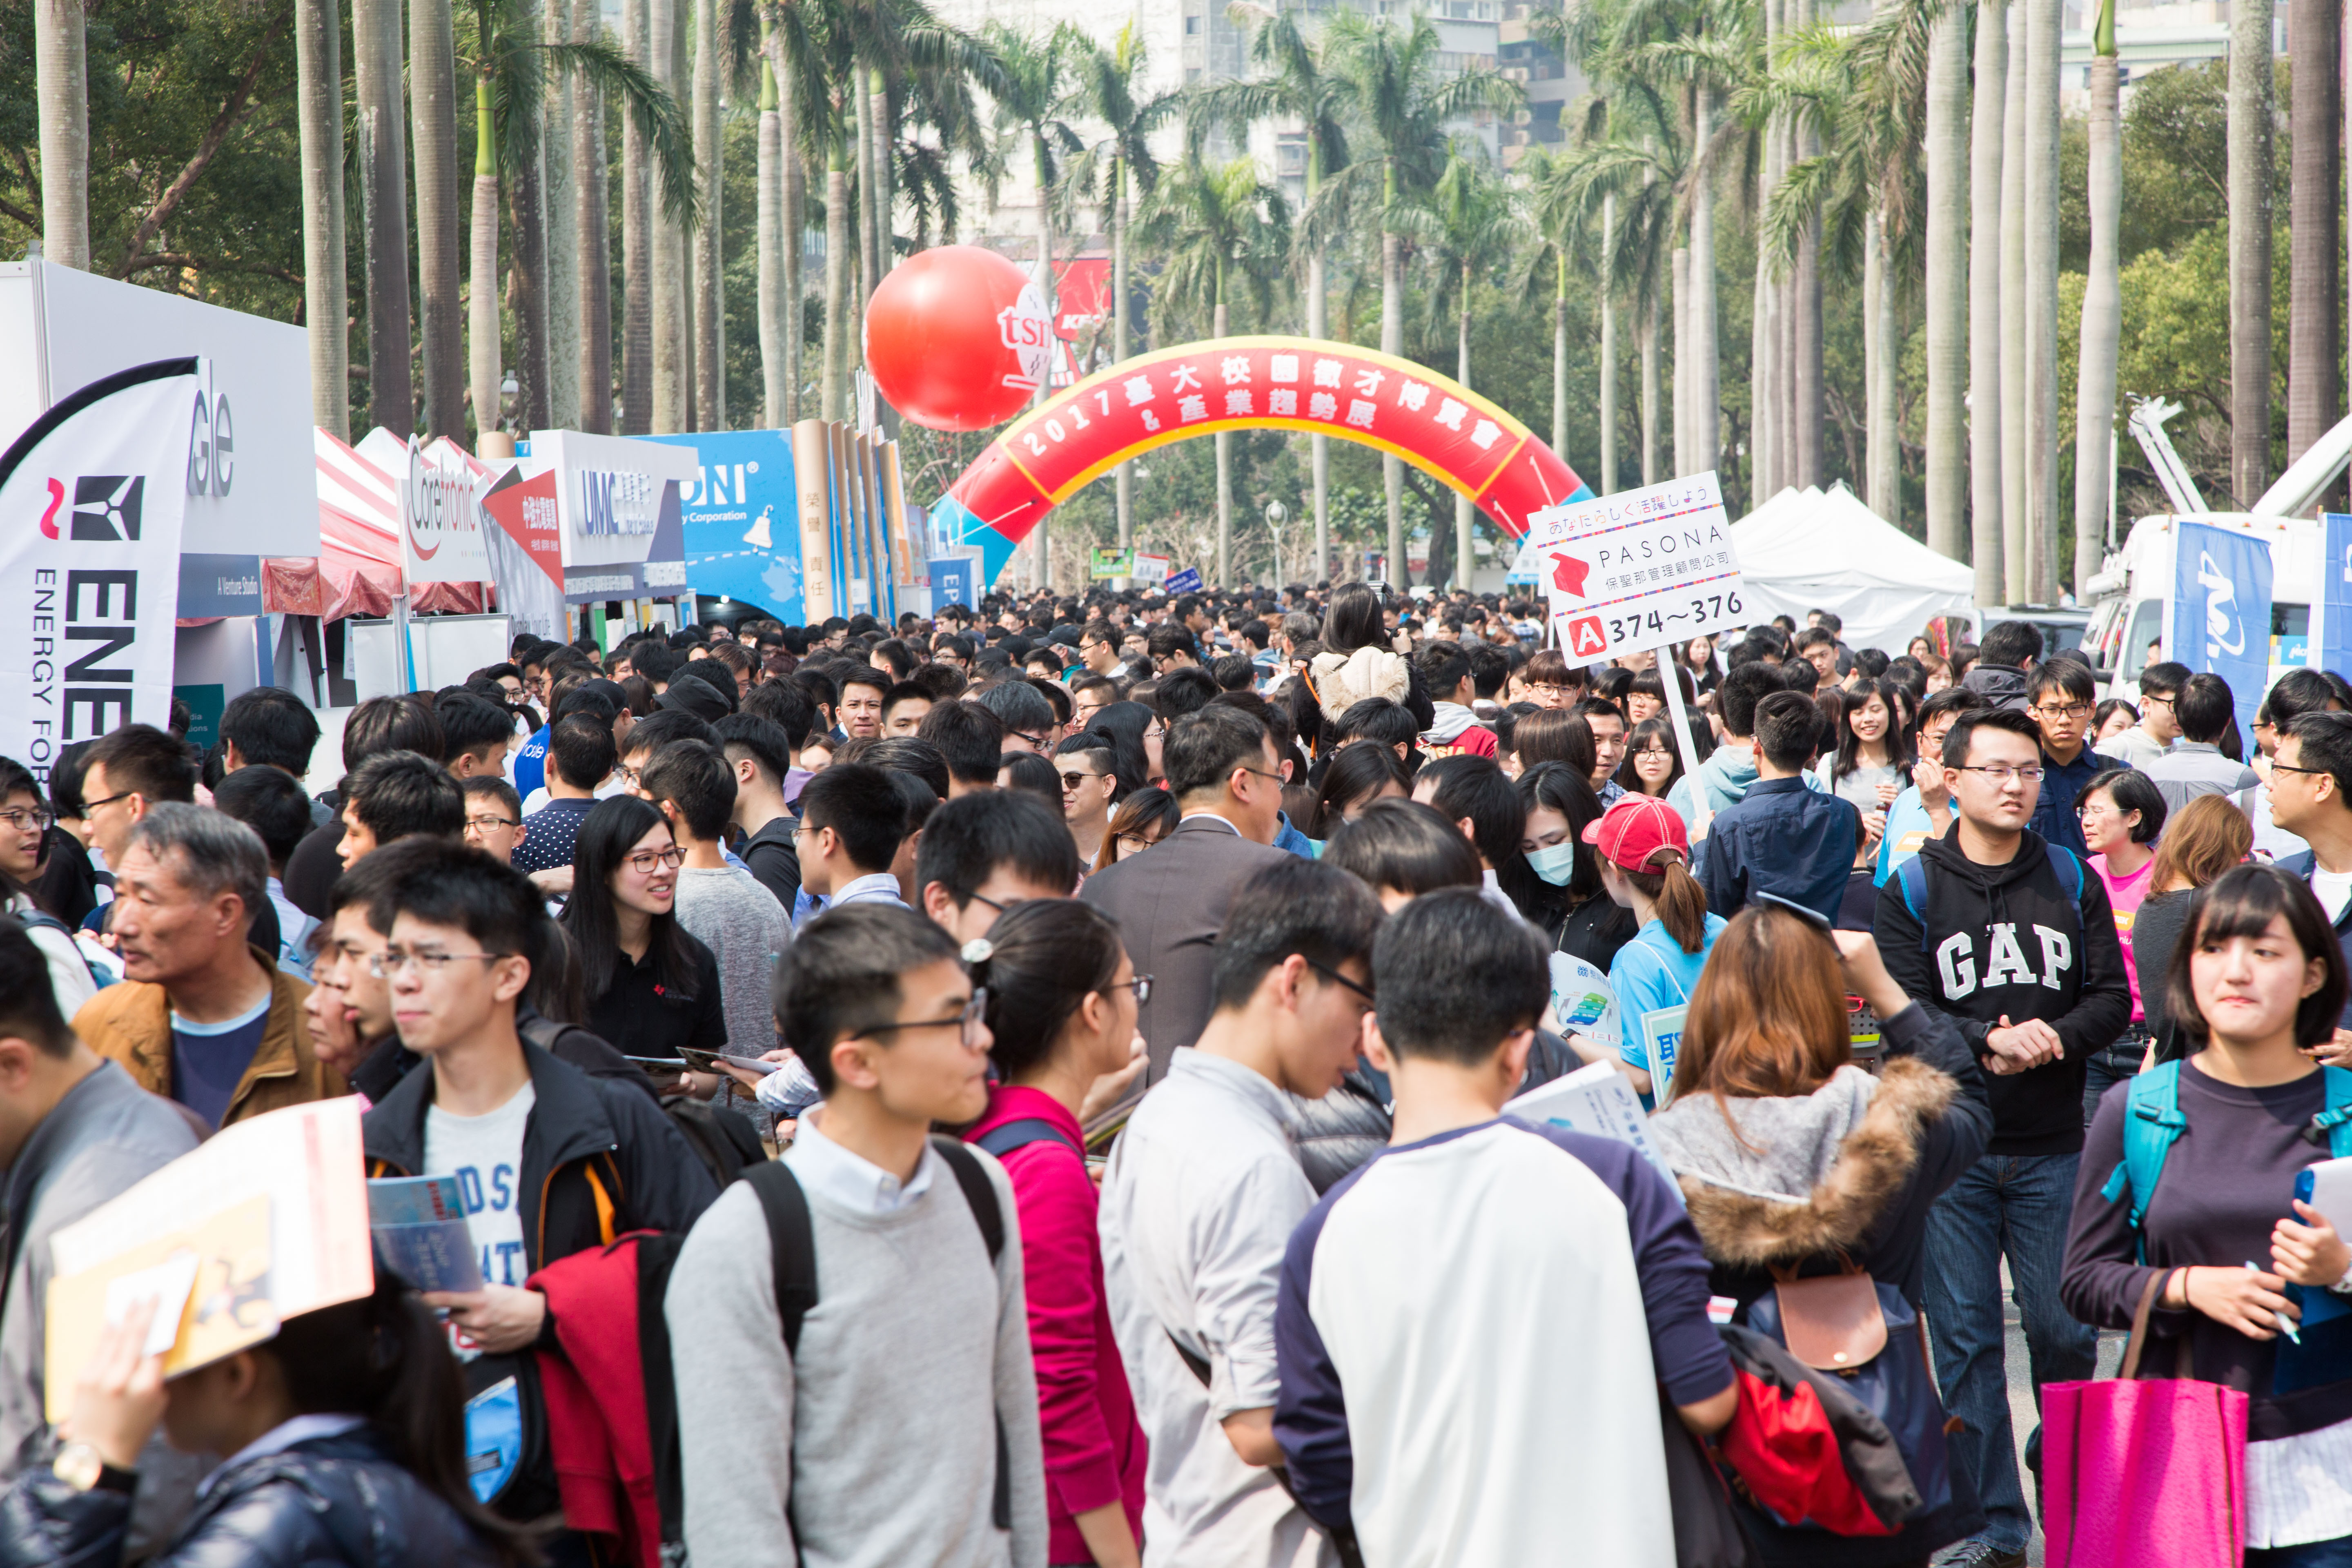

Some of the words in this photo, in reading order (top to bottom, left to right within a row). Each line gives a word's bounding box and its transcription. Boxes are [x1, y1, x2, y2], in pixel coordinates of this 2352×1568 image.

[410, 444, 476, 532] Coretronic
[1548, 486, 1707, 535] あなたらしく活躍しよう
[689, 510, 747, 524] Corporation
[1599, 525, 1723, 568] PASONA
[1605, 551, 1730, 591] 保聖那管理顧問公司
[943, 574, 960, 607] EP
[32, 569, 56, 705] ENERGY
[61, 570, 138, 752] ENE
[1577, 621, 1604, 652] A
[30, 720, 52, 784] FOR
[1936, 922, 2072, 1001] GAP
[2119, 935, 2133, 945] niu
[455, 1163, 521, 1214] DS
